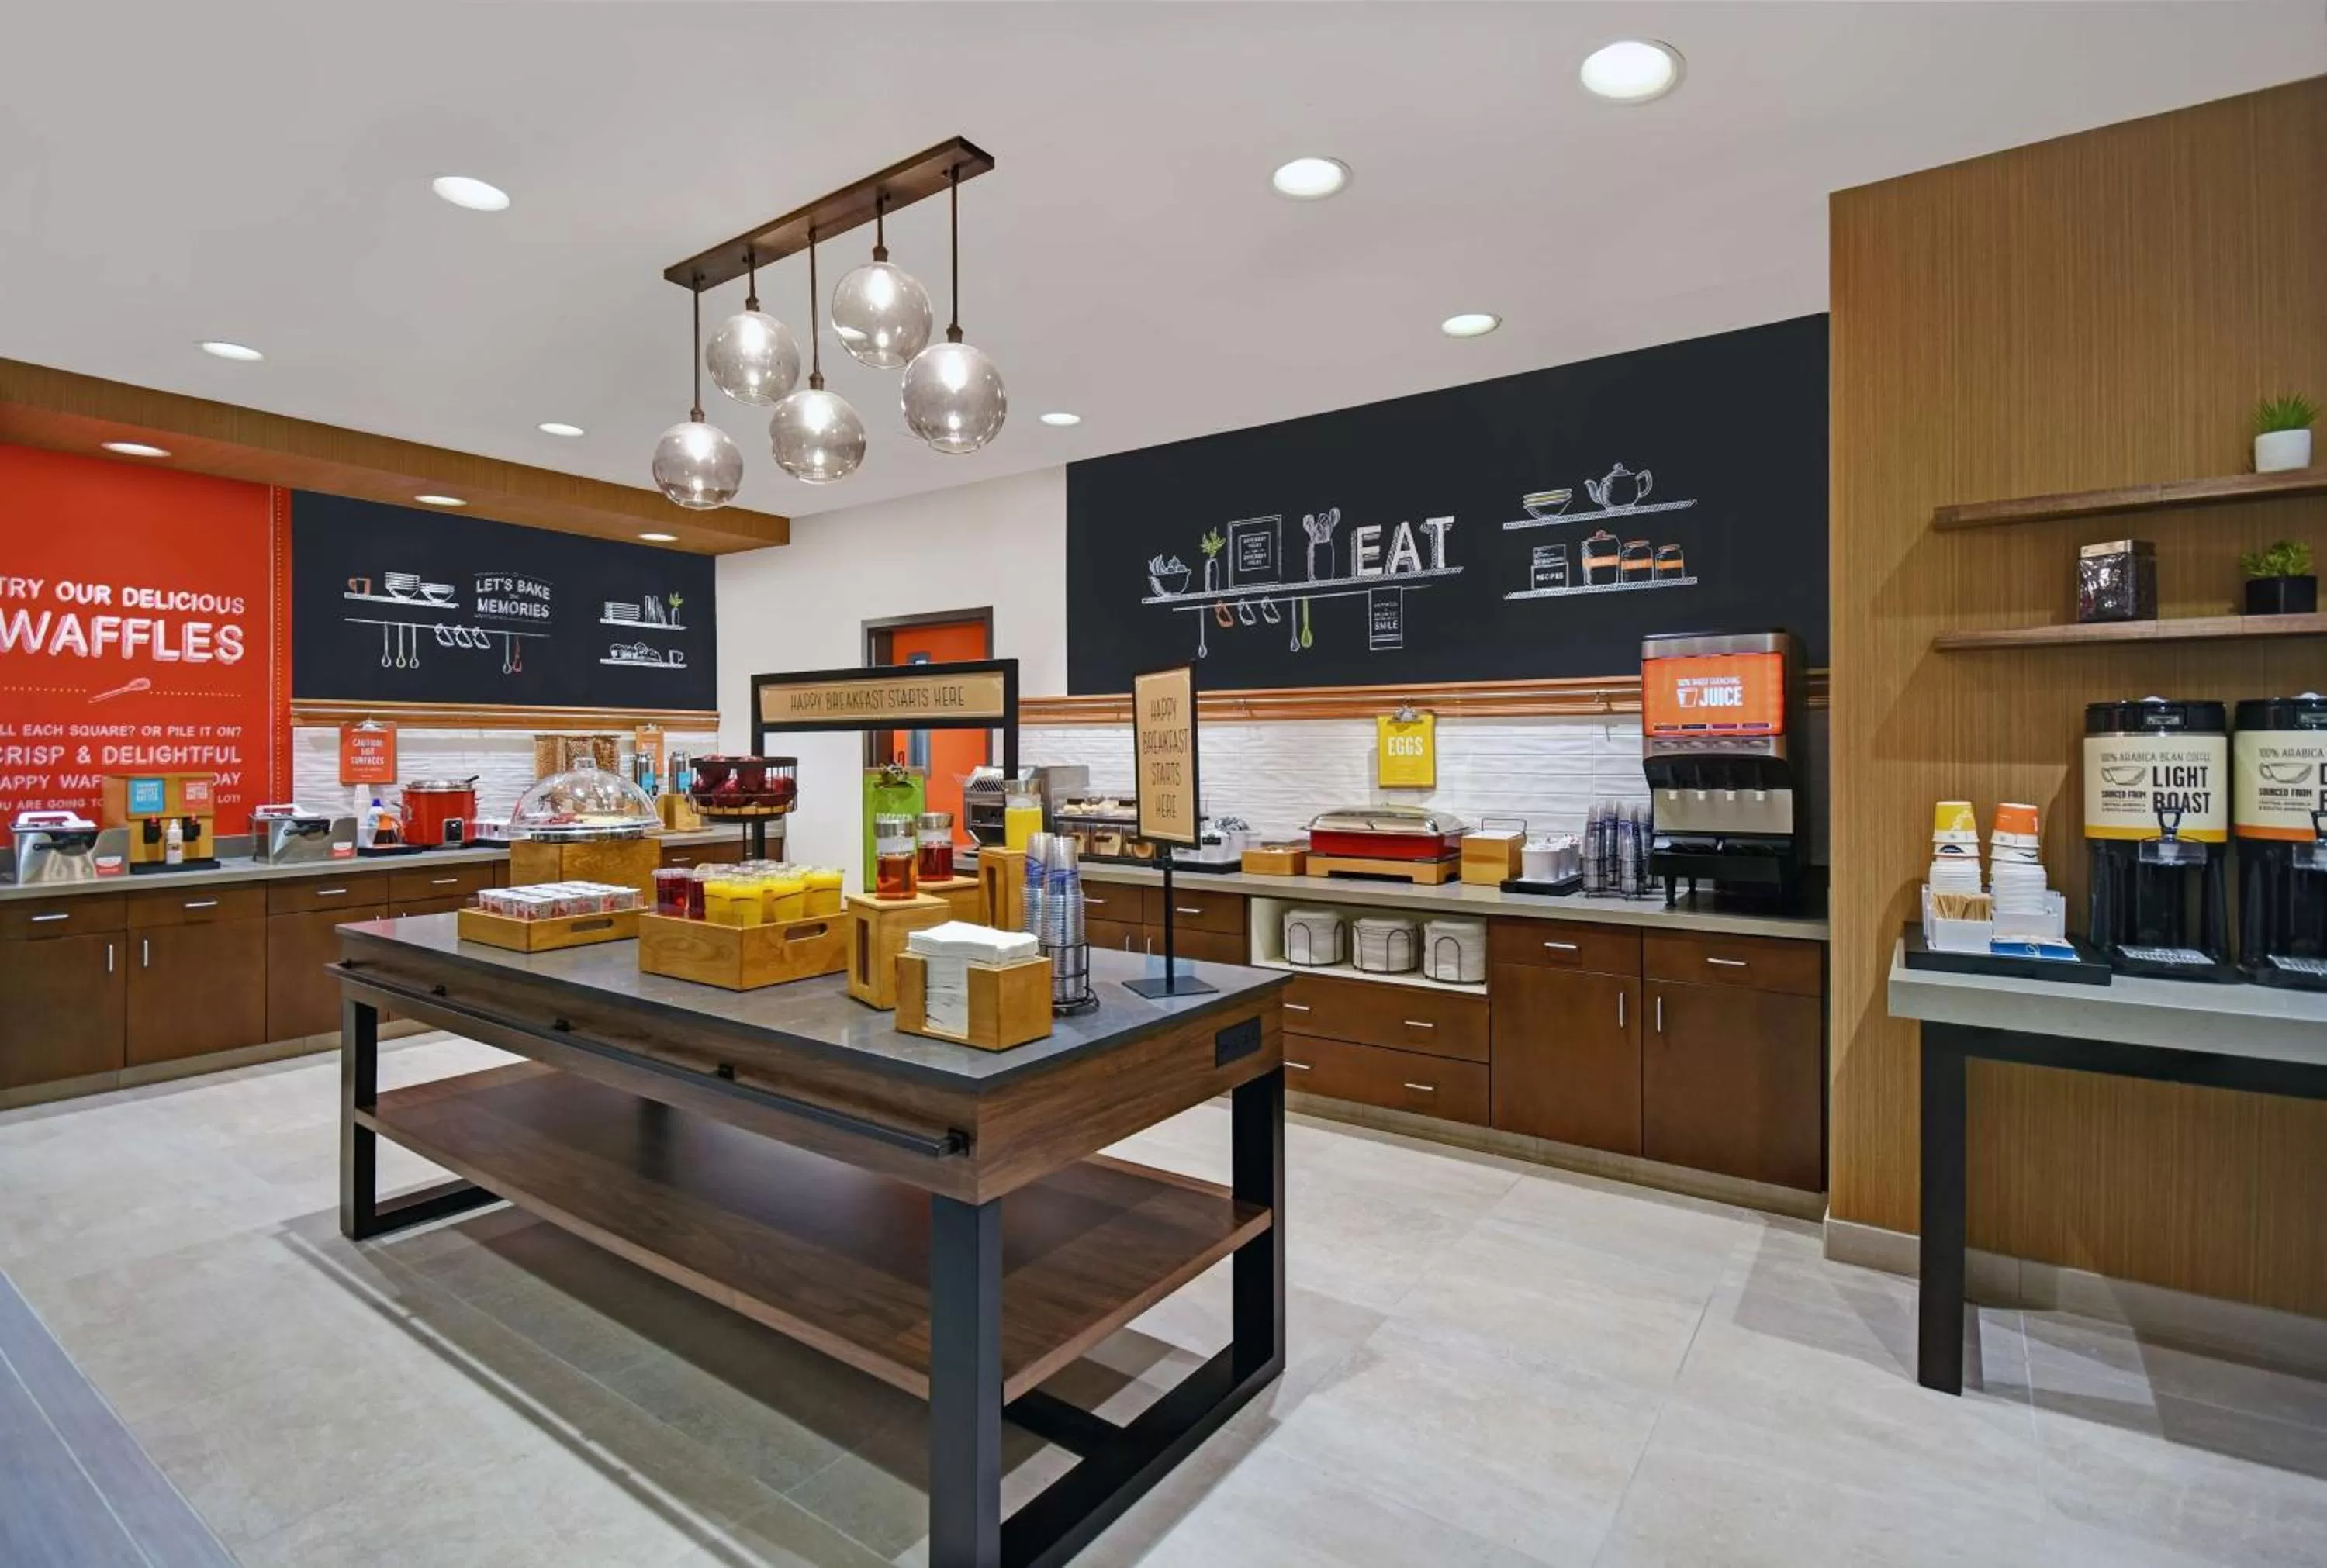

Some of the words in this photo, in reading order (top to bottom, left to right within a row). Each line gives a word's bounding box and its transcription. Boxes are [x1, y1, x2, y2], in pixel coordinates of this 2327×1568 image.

[1350, 516, 1455, 577] EAT
[55, 581, 112, 606] OUR
[122, 586, 245, 615] DELICIOUS
[476, 578, 513, 593] LET'S
[517, 579, 551, 600] BAKE
[477, 597, 551, 618] MEMORIES
[0, 607, 244, 665] WAFFLES
[790, 692, 822, 713] HAPPY
[826, 689, 885, 711] BREAKFAST
[888, 688, 929, 707] STARTS
[933, 686, 965, 706] HERE
[1699, 686, 1743, 707] JUICE
[1150, 697, 1177, 722] HAPPY
[22, 724, 63, 736] EACH
[69, 724, 136, 737] SQUARE?
[141, 725, 161, 737] OR
[168, 725, 195, 737] PILE
[199, 725, 211, 737] IT
[217, 725, 242, 737] ON?
[1143, 728, 1189, 754] BREAKFAST
[76, 745, 91, 765] &
[102, 745, 242, 765] DELIGHTFUL
[1388, 736, 1423, 757] EGGS
[2119, 752, 2157, 762] ARABICA
[2281, 748, 2324, 758] ARABICA
[1151, 762, 1181, 786] STARTS
[2152, 765, 2208, 788] LIGHT
[16, 800, 43, 810] ARE
[47, 798, 86, 809] GOING
[1155, 794, 1177, 819] HERE
